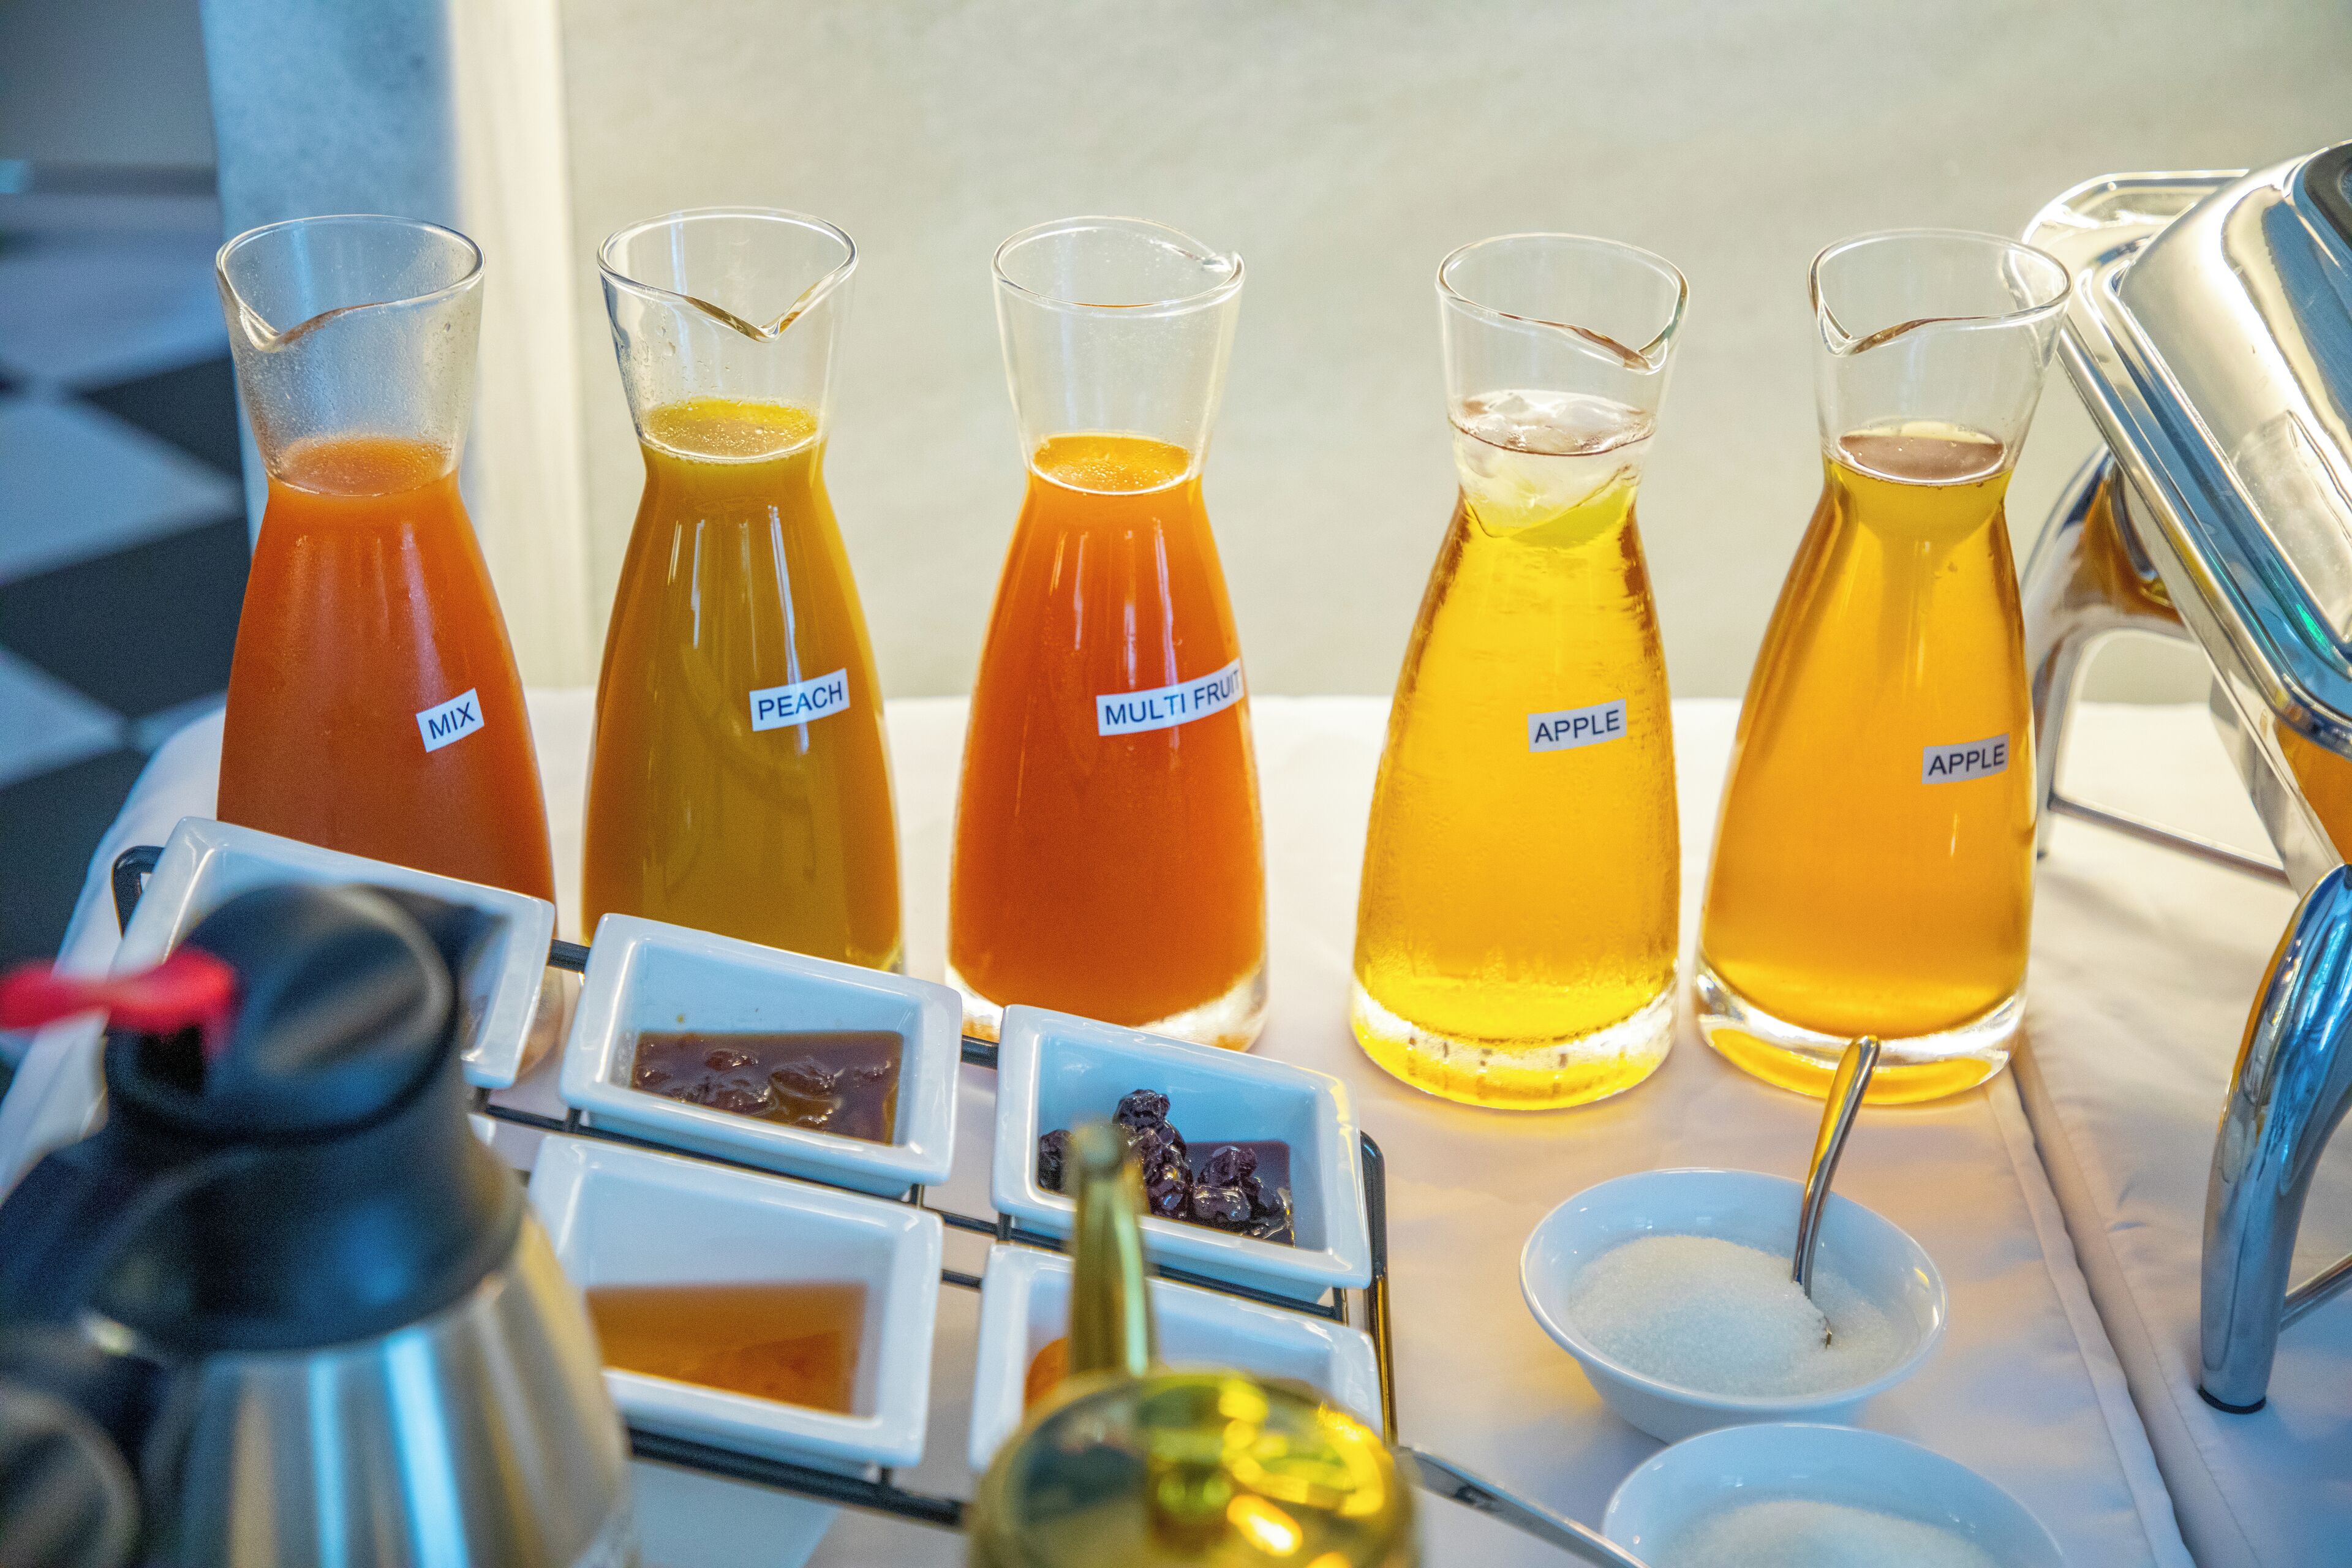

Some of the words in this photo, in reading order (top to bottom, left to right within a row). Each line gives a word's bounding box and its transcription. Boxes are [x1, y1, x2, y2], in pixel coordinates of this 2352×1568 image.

[758, 680, 842, 720] PEACH
[1105, 693, 1186, 725] MULTI
[1194, 669, 1240, 709] FRUIT
[428, 701, 475, 740] MIX
[1534, 709, 1620, 744] APPLE
[1928, 743, 2005, 776] APPLE
